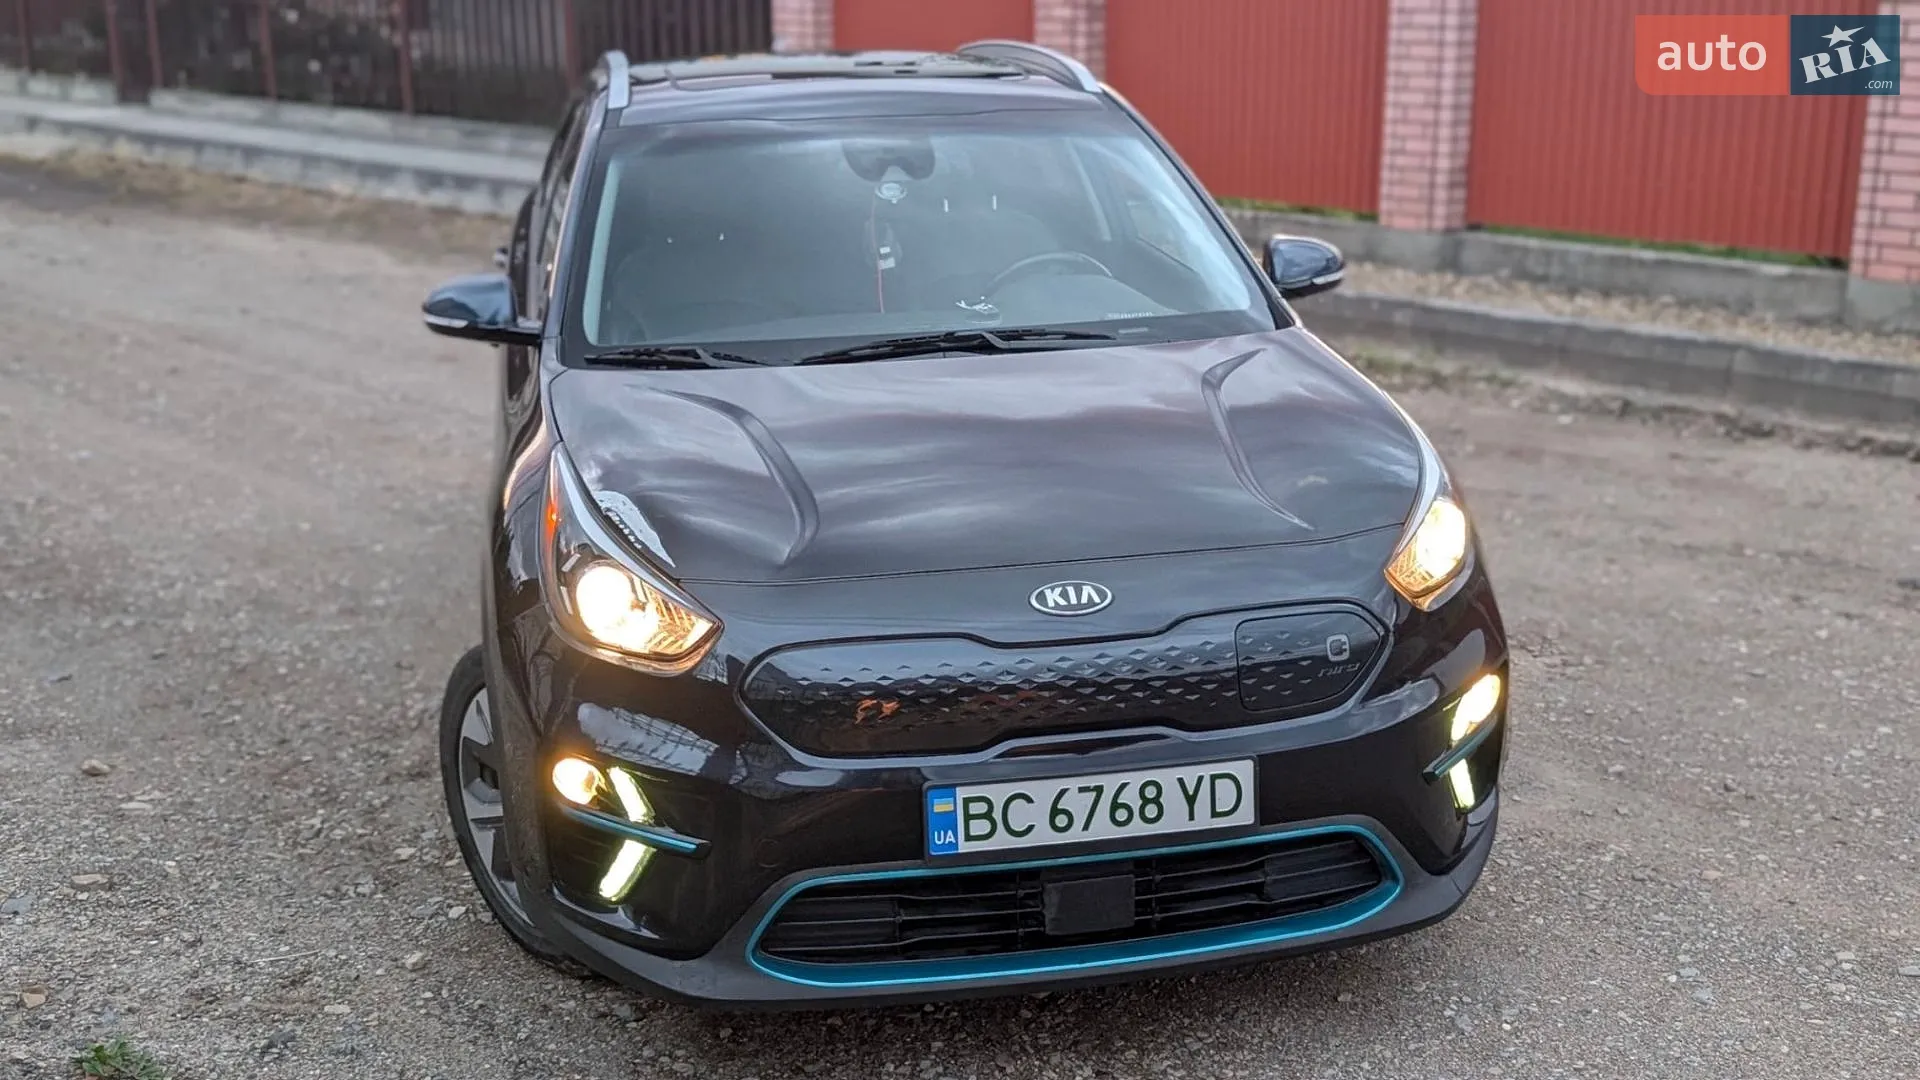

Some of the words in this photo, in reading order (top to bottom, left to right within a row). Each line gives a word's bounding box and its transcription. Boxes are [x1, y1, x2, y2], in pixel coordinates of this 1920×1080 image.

[1043, 585, 1101, 608] KIA
[961, 792, 1036, 842] BC
[1048, 779, 1164, 833] 6768
[1176, 772, 1243, 821] YD
[934, 831, 956, 845] UA
